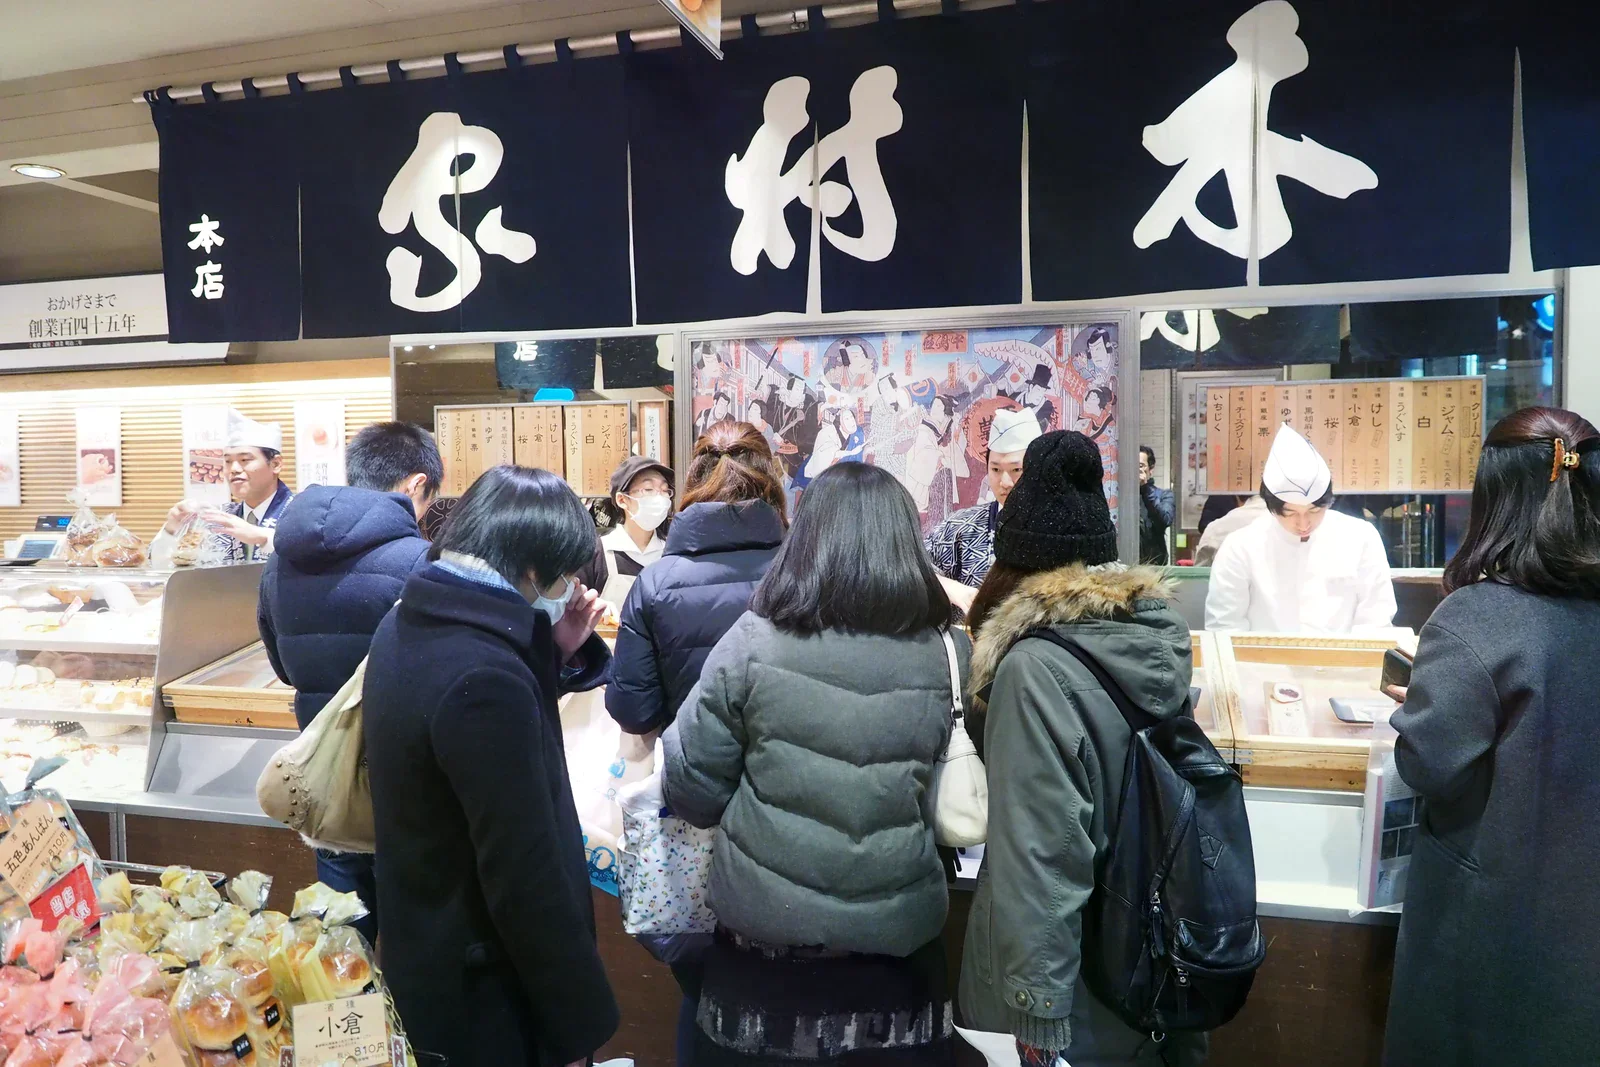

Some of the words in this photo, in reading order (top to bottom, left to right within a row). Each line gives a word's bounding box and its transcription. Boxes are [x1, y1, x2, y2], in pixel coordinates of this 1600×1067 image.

[187, 213, 225, 300] 本店
[47, 293, 117, 312] おかげさまで
[28, 313, 136, 339] 創業百四十五年
[1213, 393, 1223, 432] いちじく
[1304, 407, 1314, 442] 黒胡麻く
[1324, 418, 1339, 429] 桜
[1348, 404, 1362, 427] 小倉
[1371, 403, 1384, 428] けし
[1395, 402, 1406, 442] うぐいす
[1417, 416, 1431, 428] 白
[1441, 405, 1455, 435] ジャム
[1471, 402, 1481, 438] クリーム
[440, 414, 448, 446] いちじく
[484, 426, 493, 444] ゆず
[517, 434, 529, 445] 桜
[534, 423, 543, 443] 小倉
[549, 423, 558, 443] けし
[570, 422, 578, 456] うぐいす
[585, 433, 595, 444] 白
[601, 424, 611, 449] ジャム
[1234, 406, 1246, 451] チーズクリーム
[324, 1000, 356, 1013] 酒種
[319, 1011, 364, 1038] 小倉
[354, 1041, 385, 1057] 810円
